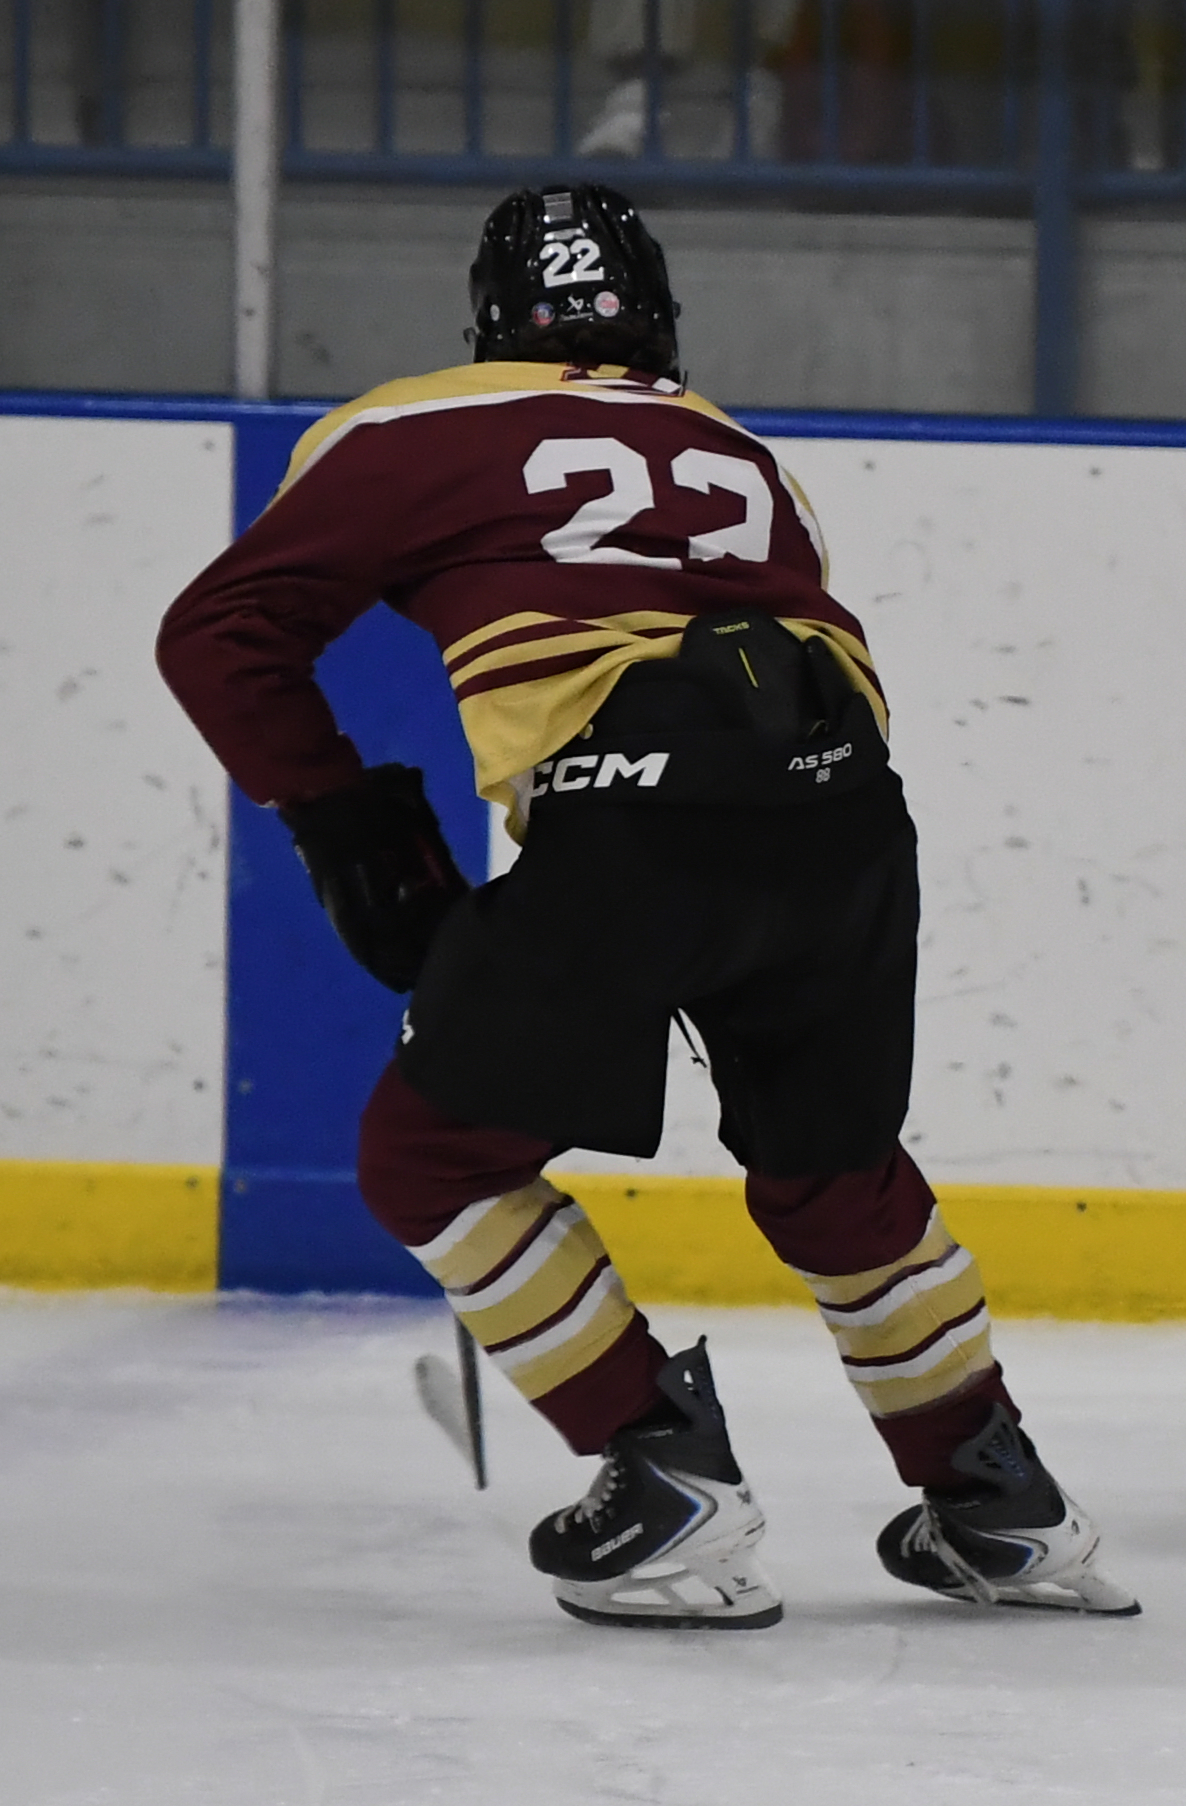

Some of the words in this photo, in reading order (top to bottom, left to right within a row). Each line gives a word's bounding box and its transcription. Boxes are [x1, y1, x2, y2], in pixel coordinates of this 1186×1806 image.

[539, 238, 604, 288] 22
[522, 437, 774, 571] 22
[532, 752, 670, 798] CCM
[787, 754, 819, 771] AS
[590, 1523, 644, 1562] BAUER
